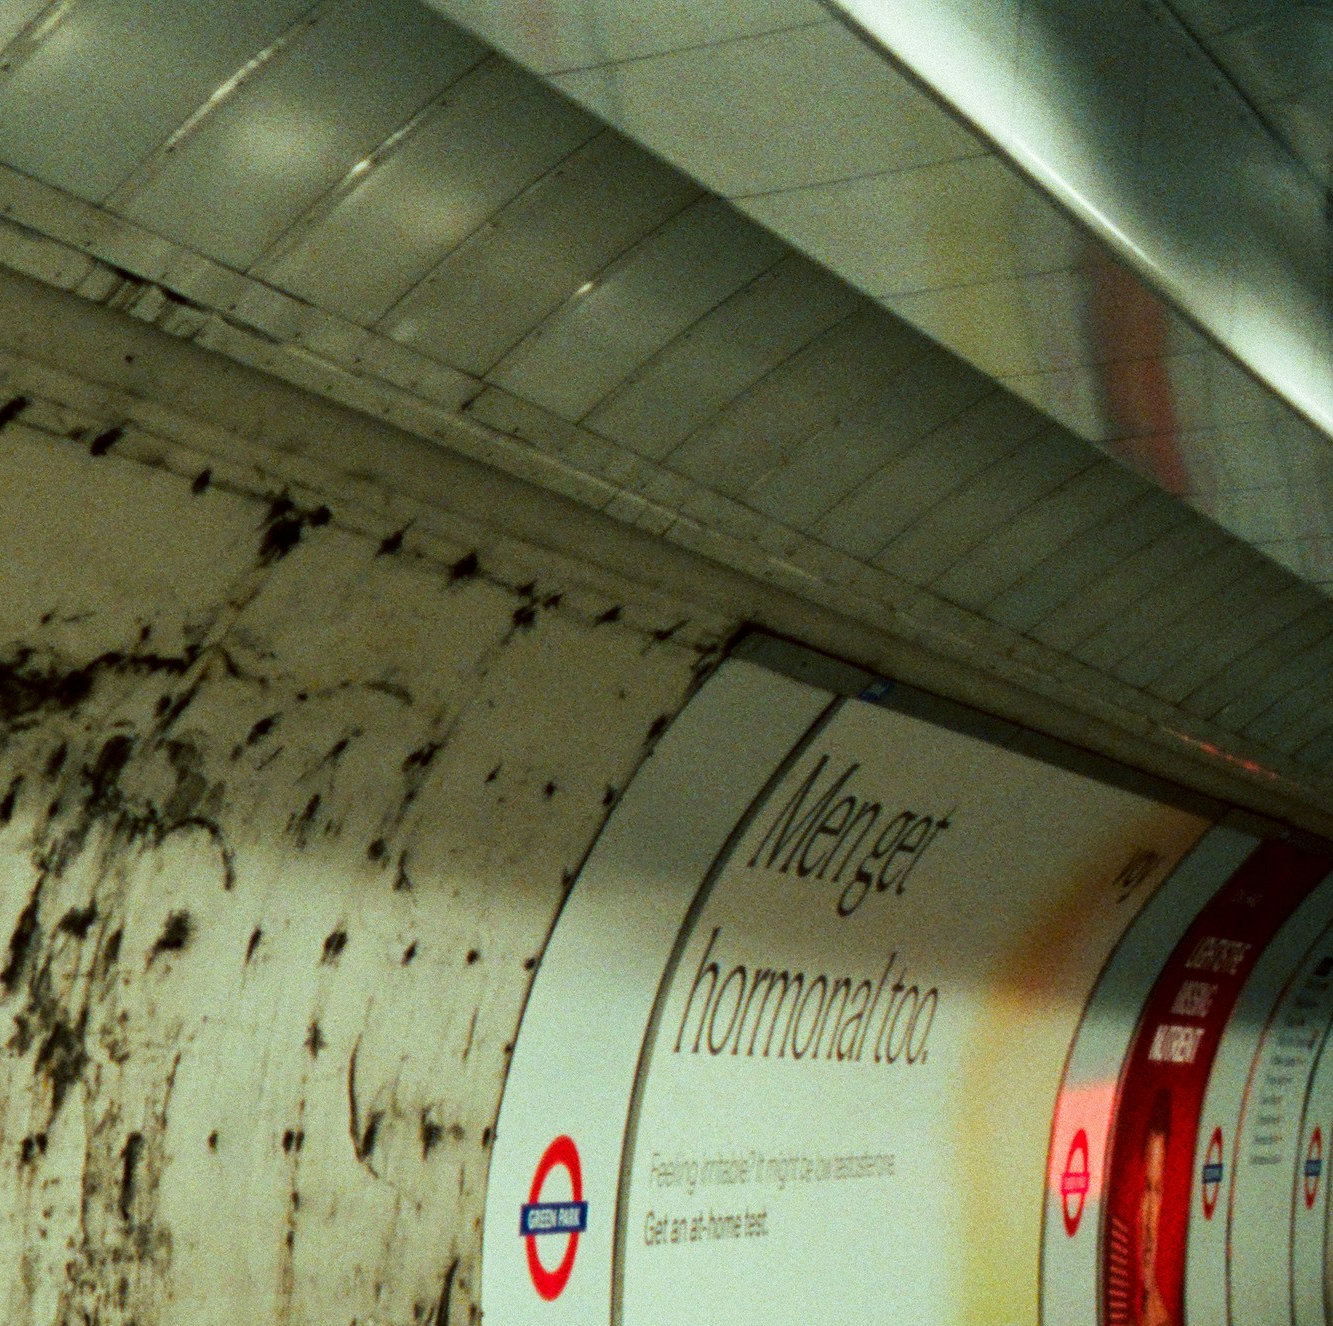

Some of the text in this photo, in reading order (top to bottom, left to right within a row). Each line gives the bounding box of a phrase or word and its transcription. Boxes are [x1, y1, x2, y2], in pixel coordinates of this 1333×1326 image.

[746, 754, 955, 917] Men get
[673, 926, 939, 1065] hormonal too.
[649, 1151, 697, 1196] Feeling
[527, 1206, 581, 1230] GREEN PARK
[644, 1209, 668, 1246] Get
[670, 1216, 688, 1244] an
